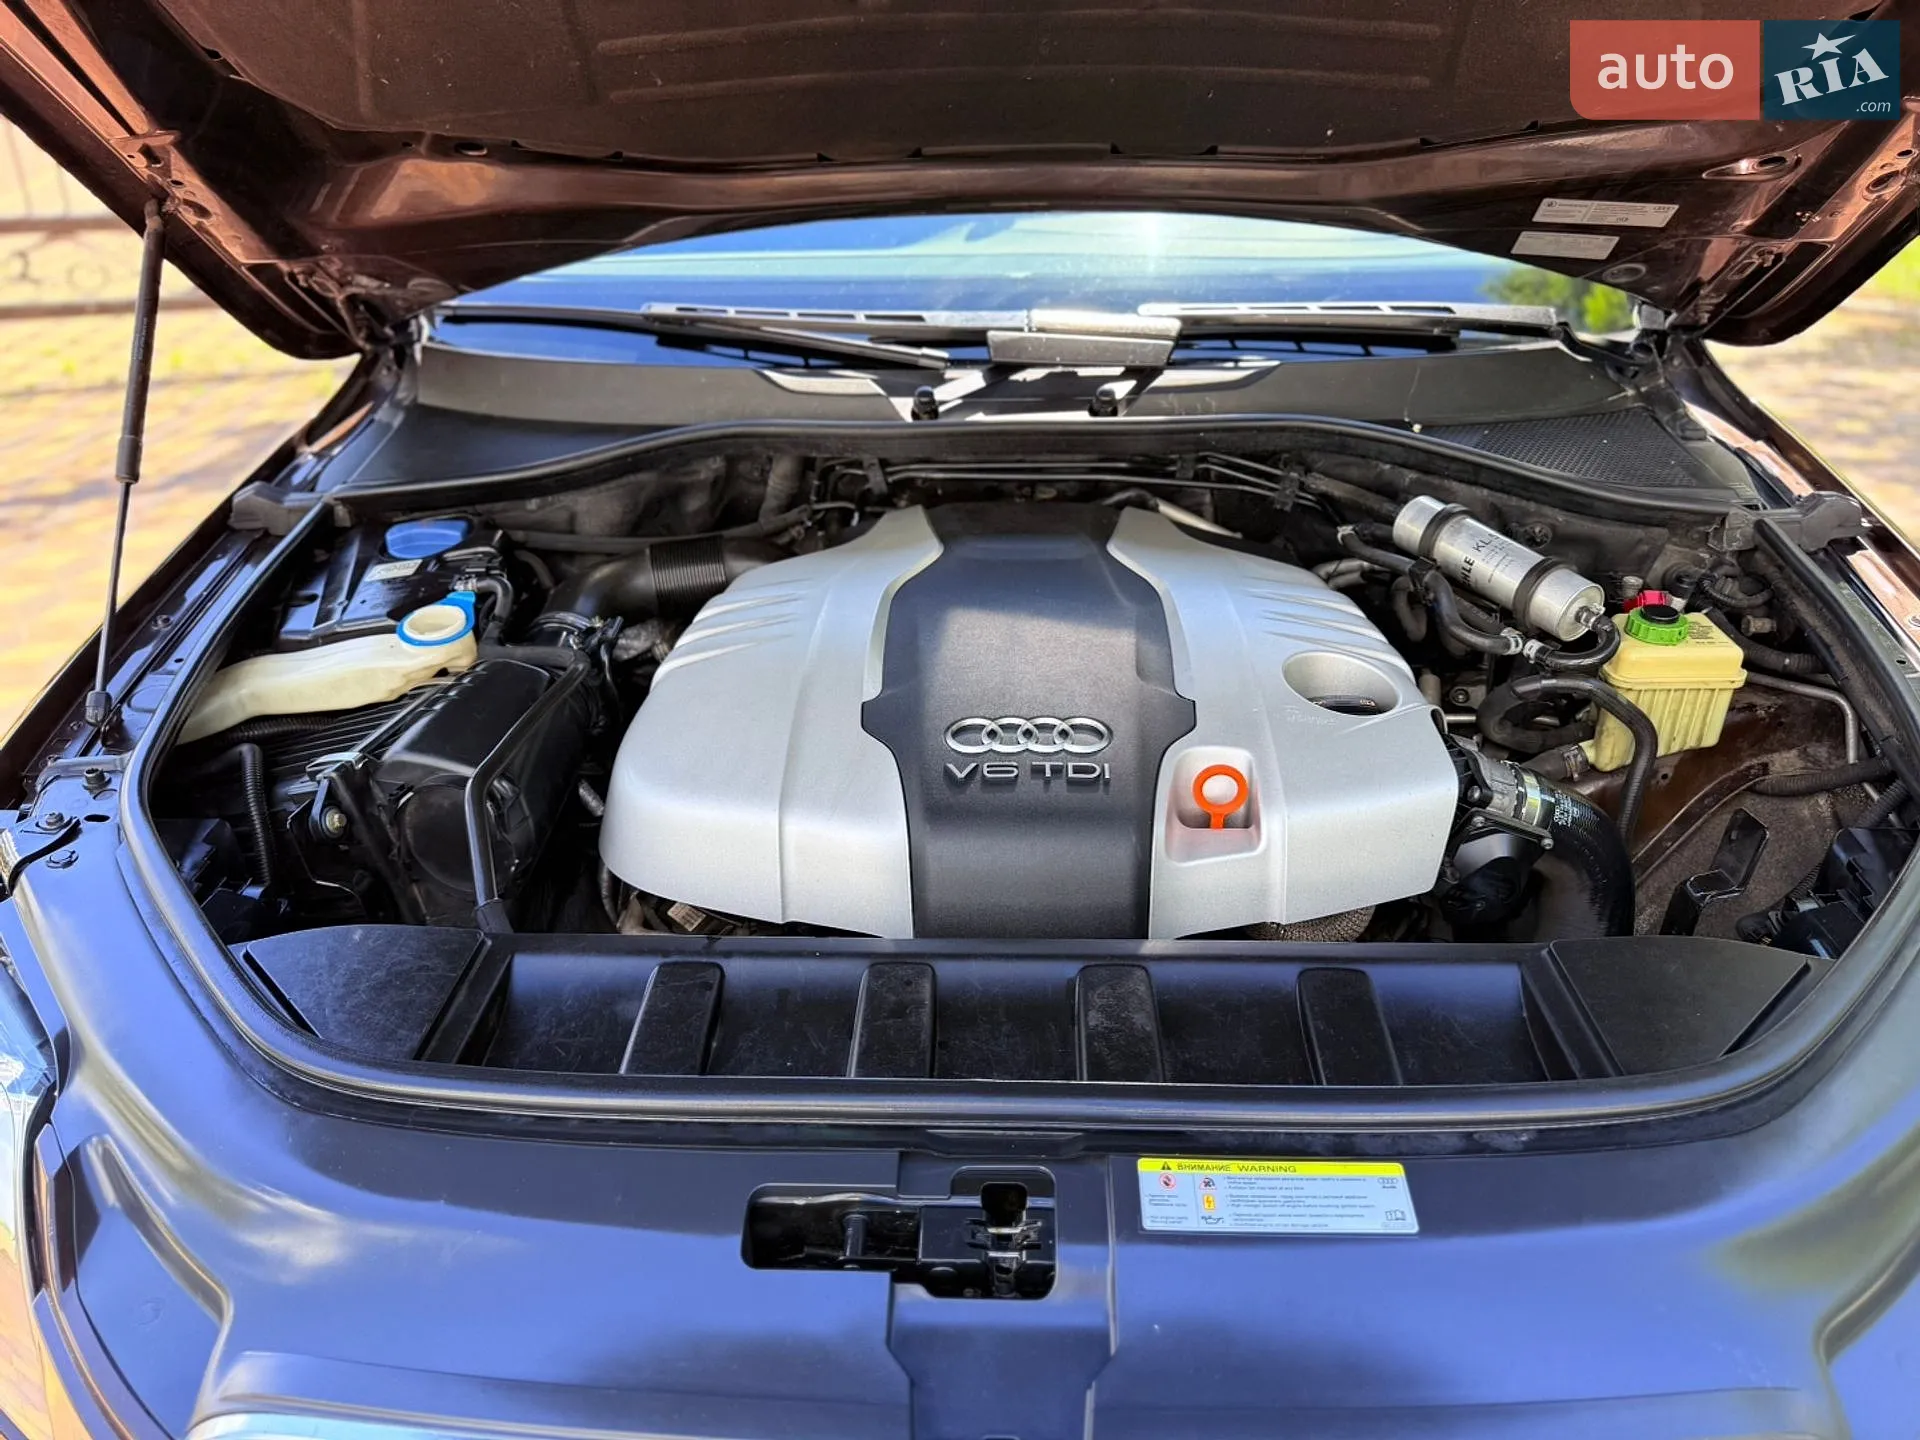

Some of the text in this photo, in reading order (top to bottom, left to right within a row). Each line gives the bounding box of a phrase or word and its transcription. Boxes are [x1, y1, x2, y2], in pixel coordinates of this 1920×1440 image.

[945, 762, 1111, 779] V6 TDI
[1177, 1163, 1297, 1173] ВНИМАНИЕ WARNING
